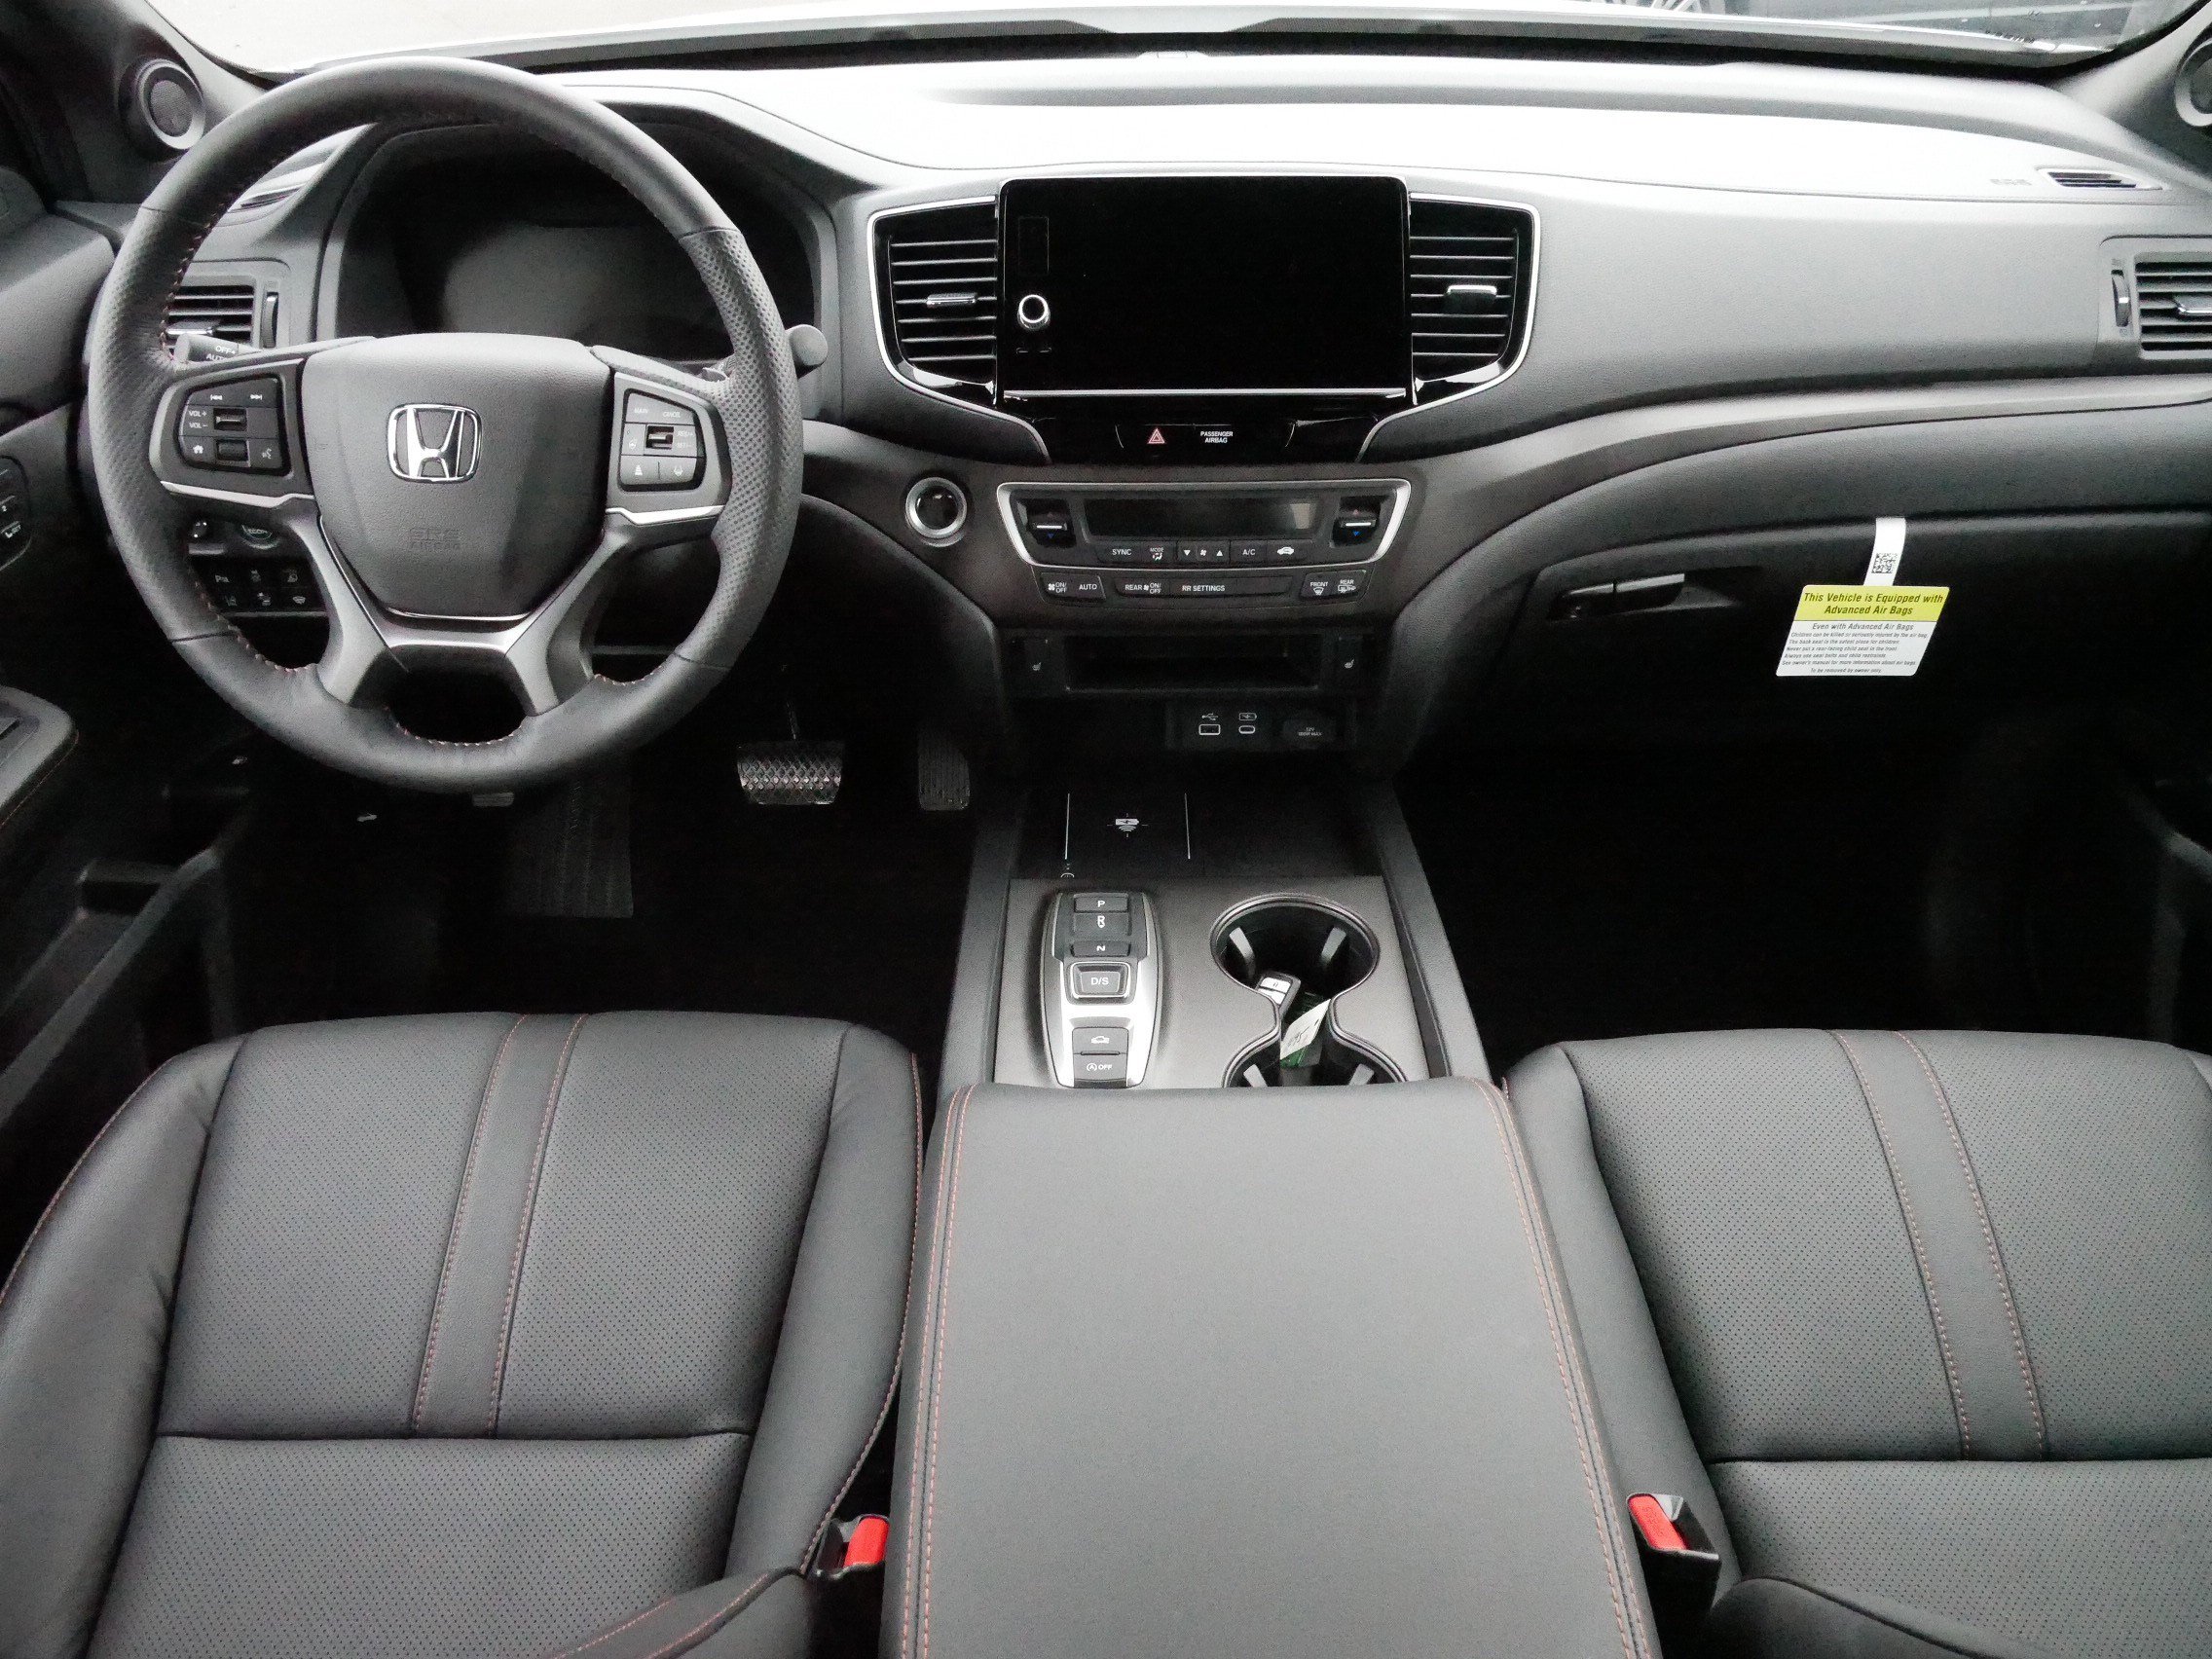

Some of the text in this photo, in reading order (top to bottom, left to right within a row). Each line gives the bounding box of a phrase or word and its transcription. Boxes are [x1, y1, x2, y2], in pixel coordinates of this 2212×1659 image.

[215, 345, 230, 354] OFF
[1112, 547, 1132, 557] SYNC
[1242, 547, 1256, 557] A/C
[1078, 582, 1098, 591] AUTO
[1124, 583, 1143, 592] REAR
[1804, 592, 1943, 605] This Vehicle is Equipped with
[1824, 606, 1913, 616] Advanced Air Bags
[1097, 914, 1105, 923] R
[1090, 977, 1109, 986] D/S
